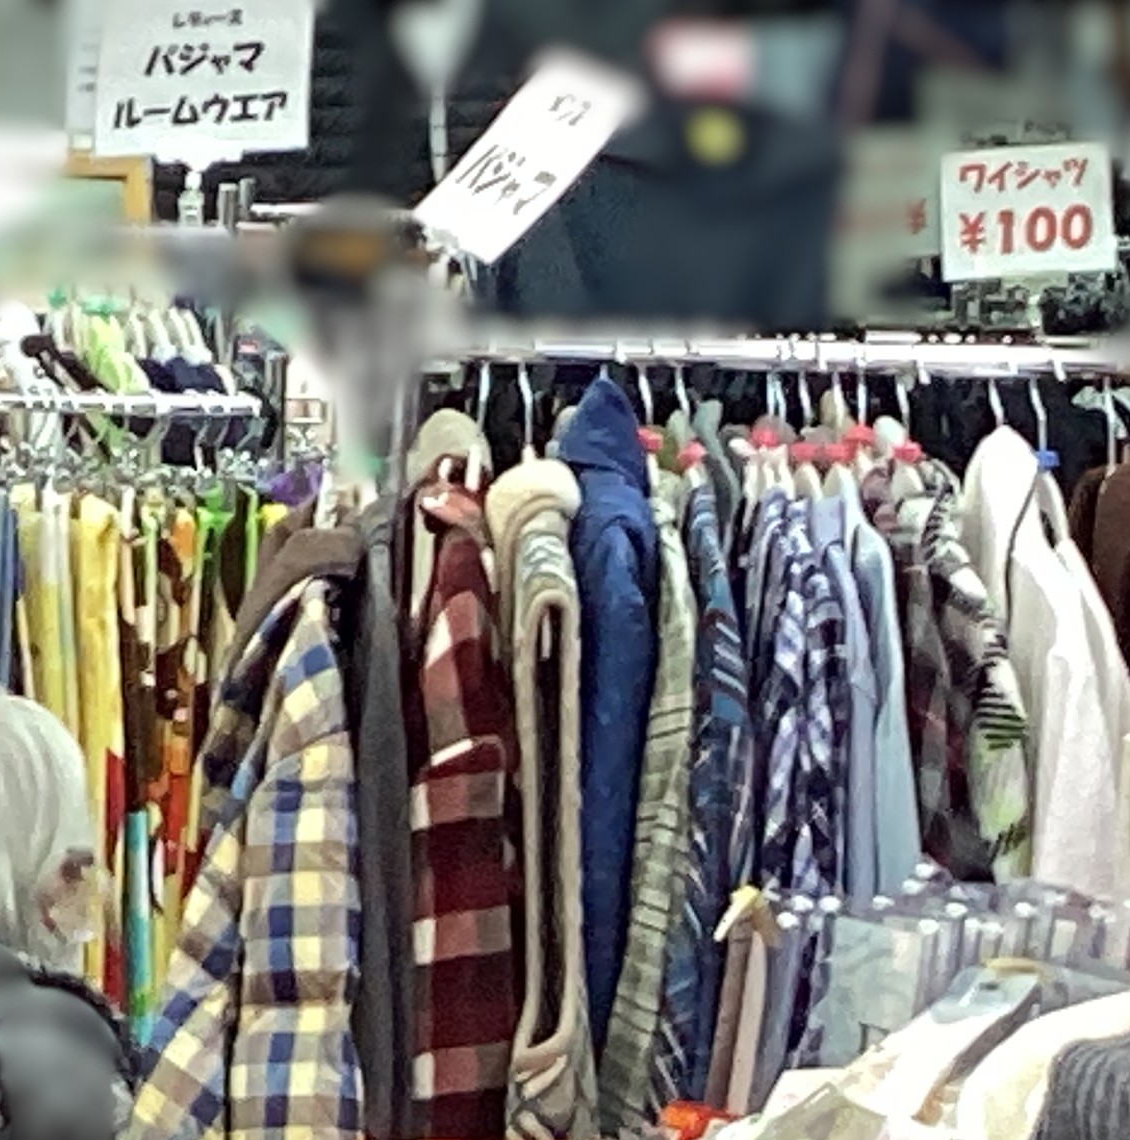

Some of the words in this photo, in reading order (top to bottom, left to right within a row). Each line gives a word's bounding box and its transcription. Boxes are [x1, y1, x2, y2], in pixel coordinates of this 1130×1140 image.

[114, 91, 287, 128] ルームウエア
[959, 158, 1089, 193] ワイシャツ
[959, 204, 1093, 254] ¥100
